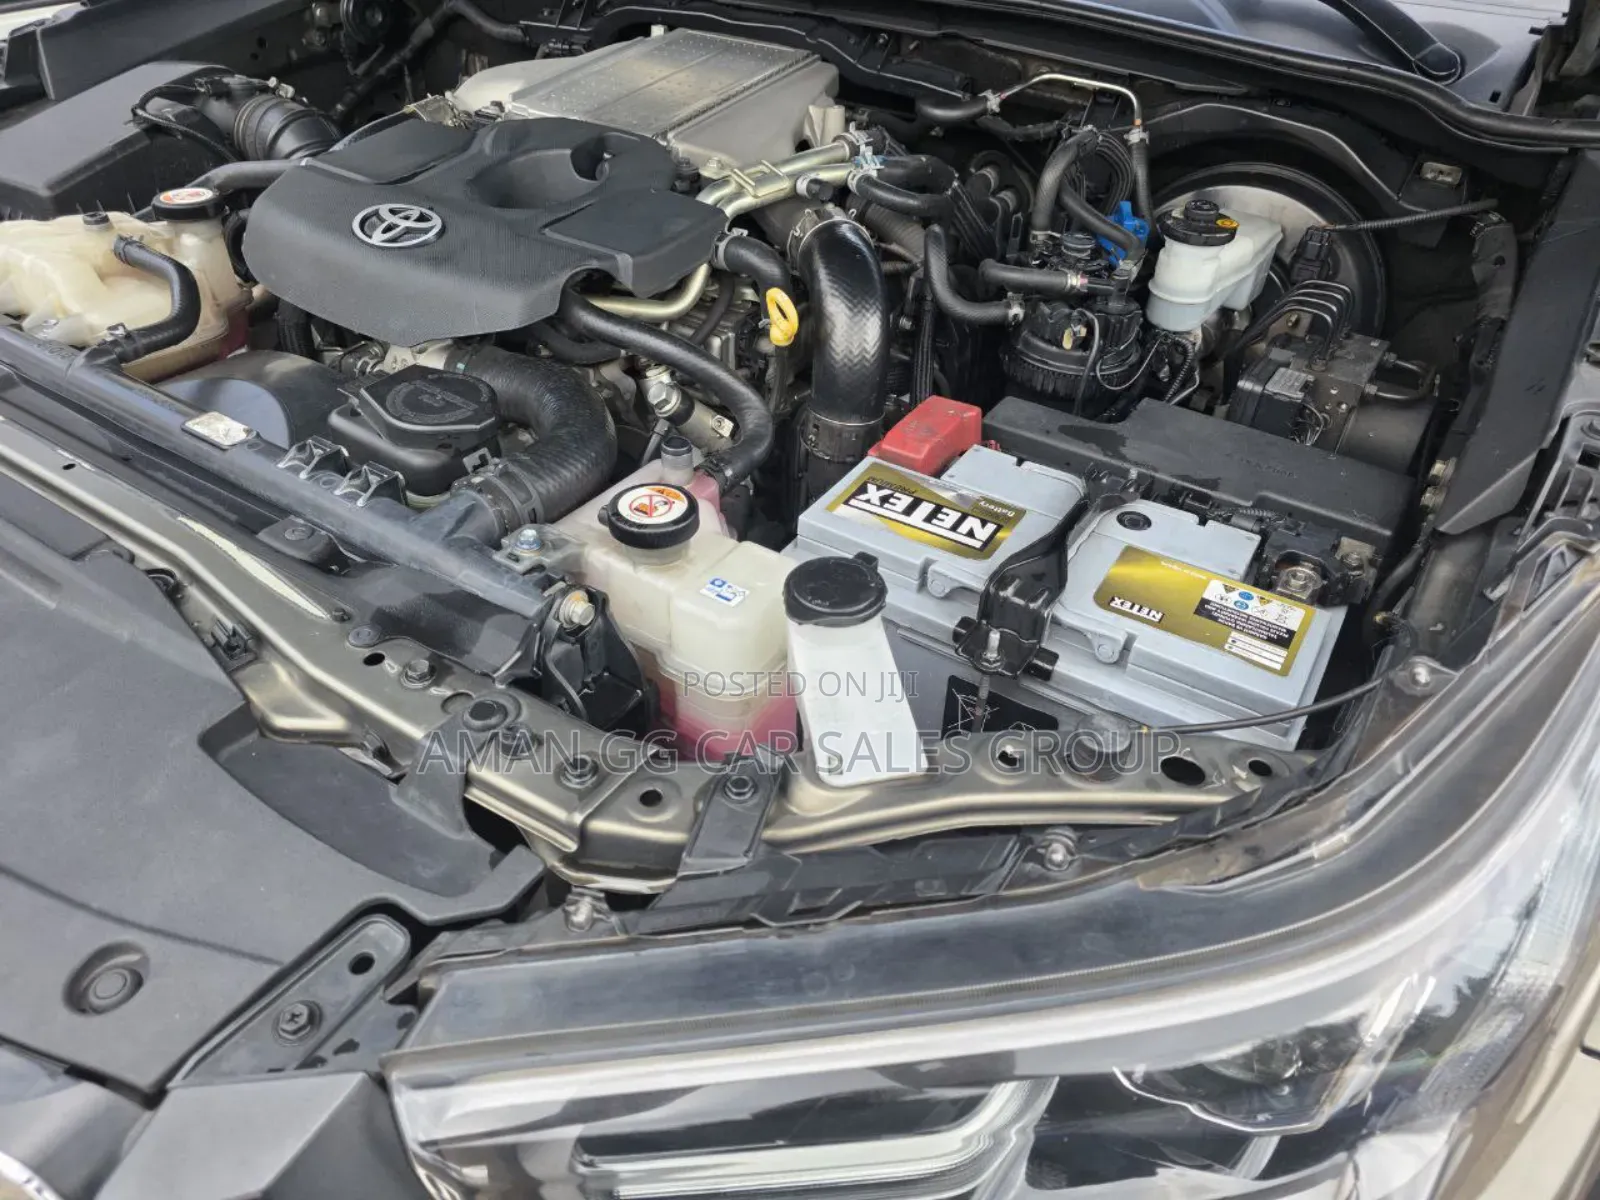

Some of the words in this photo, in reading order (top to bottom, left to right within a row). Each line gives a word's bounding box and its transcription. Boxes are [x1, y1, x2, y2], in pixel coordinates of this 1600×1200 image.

[848, 482, 998, 550] NETEX
[979, 499, 1016, 518] Battery
[1109, 596, 1163, 623] NETEX
